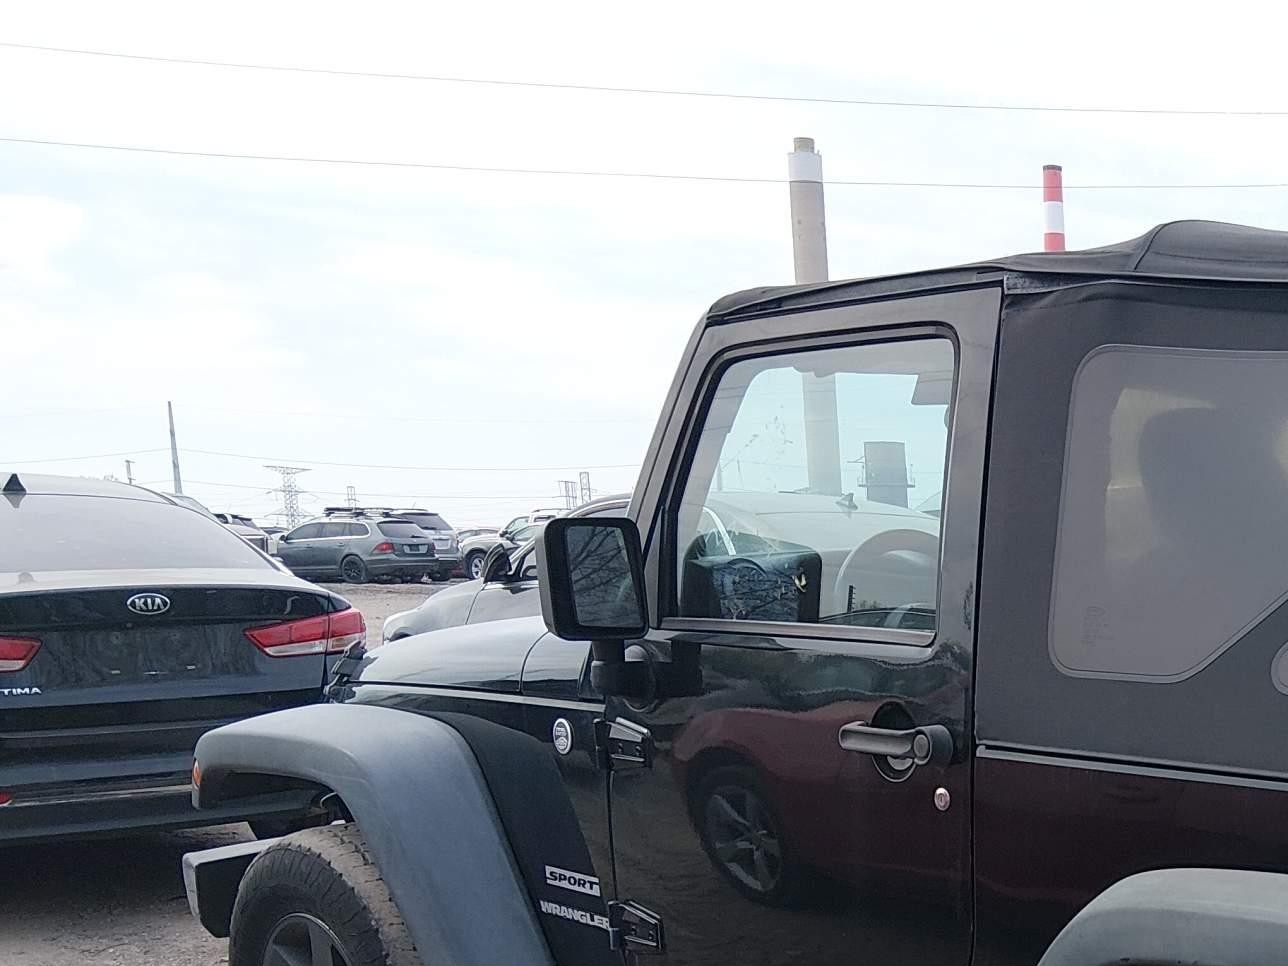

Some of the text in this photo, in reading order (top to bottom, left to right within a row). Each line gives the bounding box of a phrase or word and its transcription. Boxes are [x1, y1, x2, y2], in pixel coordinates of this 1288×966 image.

[134, 597, 165, 610] KIA
[0, 687, 42, 696] TIMA
[549, 871, 599, 891] SPORT
[540, 899, 610, 931] WRANGLER
